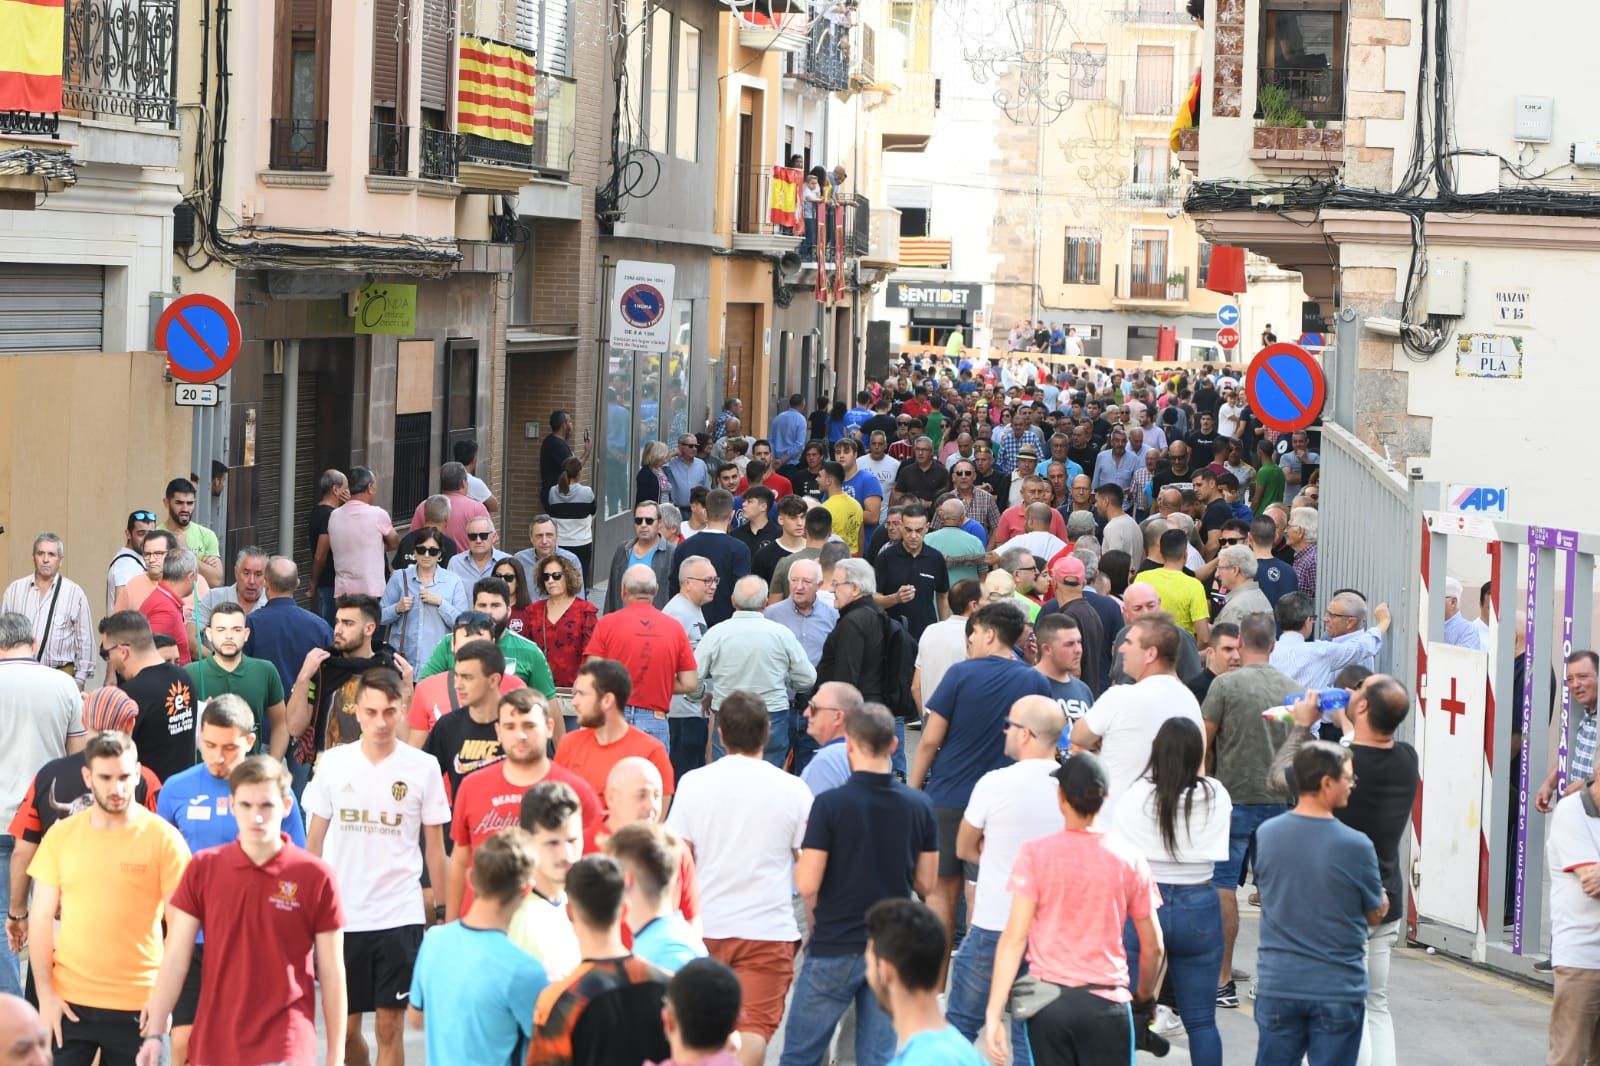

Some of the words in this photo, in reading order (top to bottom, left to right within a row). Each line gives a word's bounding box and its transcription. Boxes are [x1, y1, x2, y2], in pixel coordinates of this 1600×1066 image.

[898, 286, 969, 304] SENTIDET
[1514, 308, 1524, 320] 15
[1218, 335, 1239, 343] STOP
[1481, 342, 1496, 354] EL
[1480, 357, 1507, 372] PLA
[182, 389, 197, 401] 20
[1459, 487, 1505, 512] API
[1527, 552, 1537, 634] DAVANT
[459, 739, 501, 760] NIKE
[340, 808, 403, 828] BLU
[1514, 840, 1525, 949] SEXISTES
